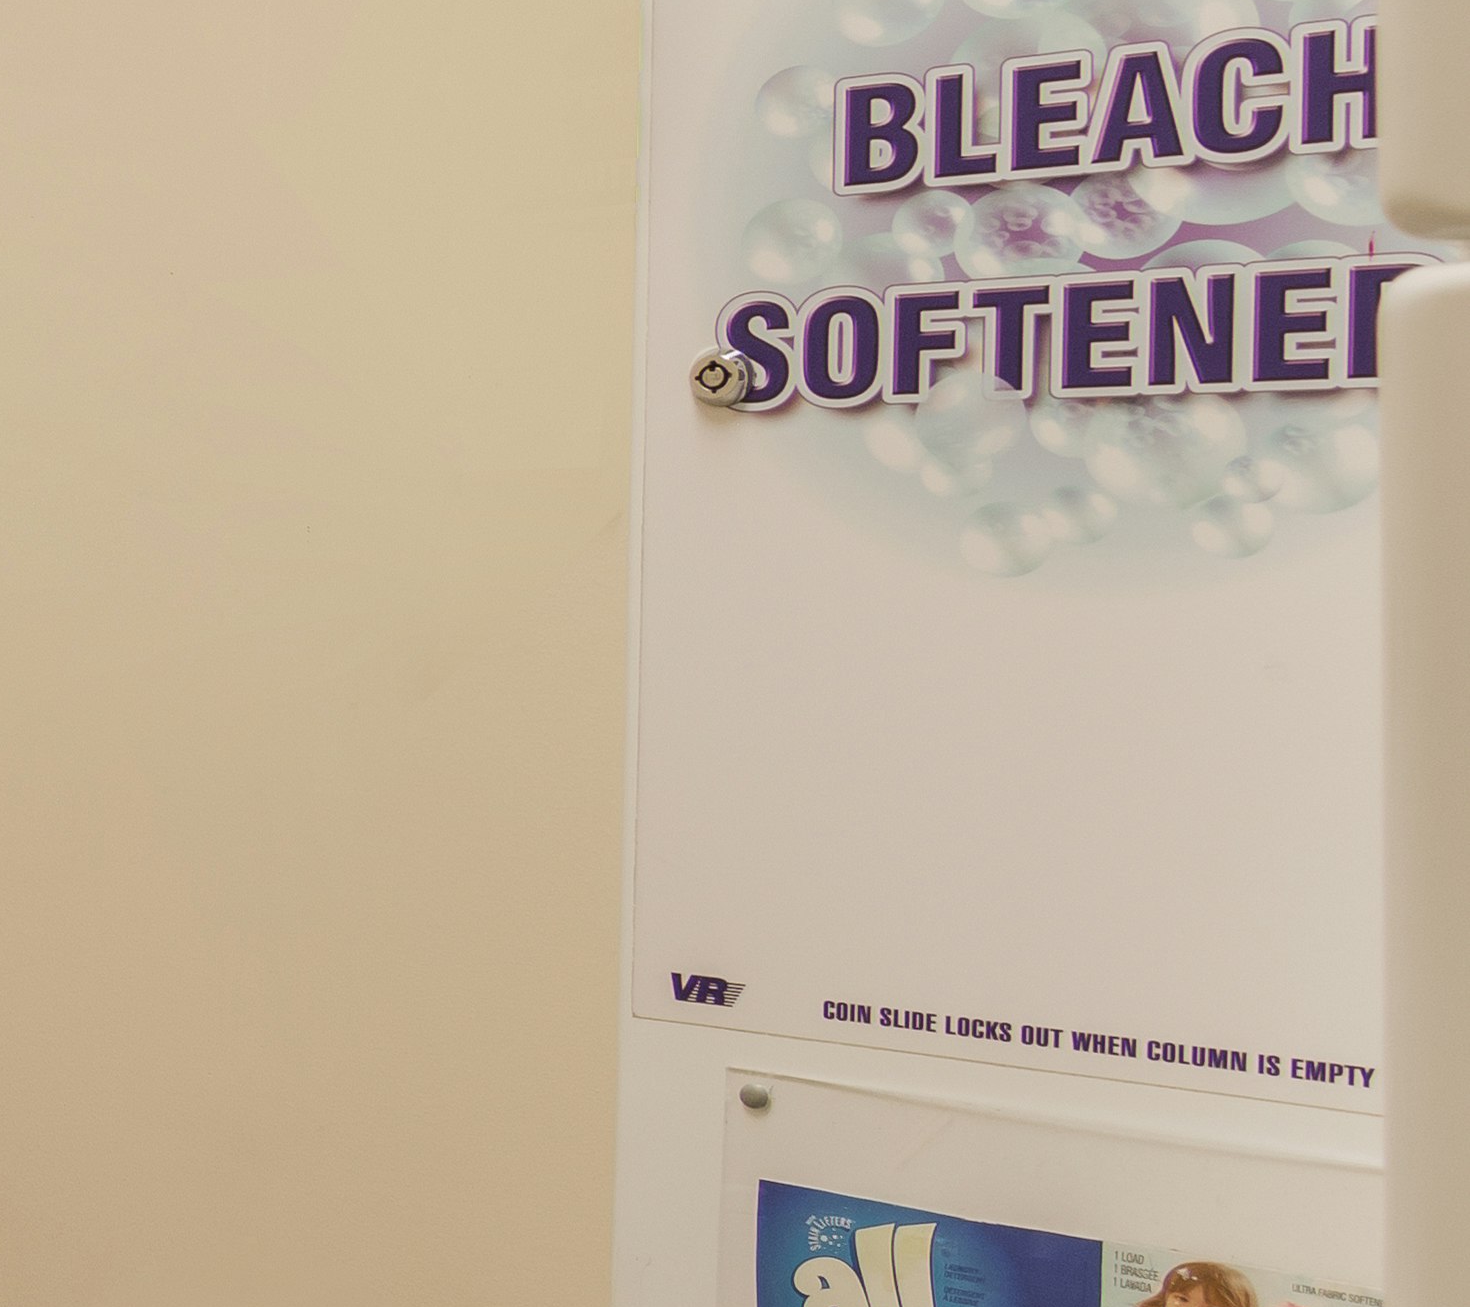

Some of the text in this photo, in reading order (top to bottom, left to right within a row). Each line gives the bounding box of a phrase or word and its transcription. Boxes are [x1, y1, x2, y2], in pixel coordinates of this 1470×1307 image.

[842, 24, 1380, 187] BLEACH
[822, 999, 1376, 1089] COIN SLIDE LOCKS OUT WHEN COLUMN IS EMPTY
[1121, 1251, 1144, 1265] LOAD
[1120, 1278, 1152, 1293] LAVADA
[1292, 1283, 1383, 1307] ULTRA FABRIC SOFTENE
